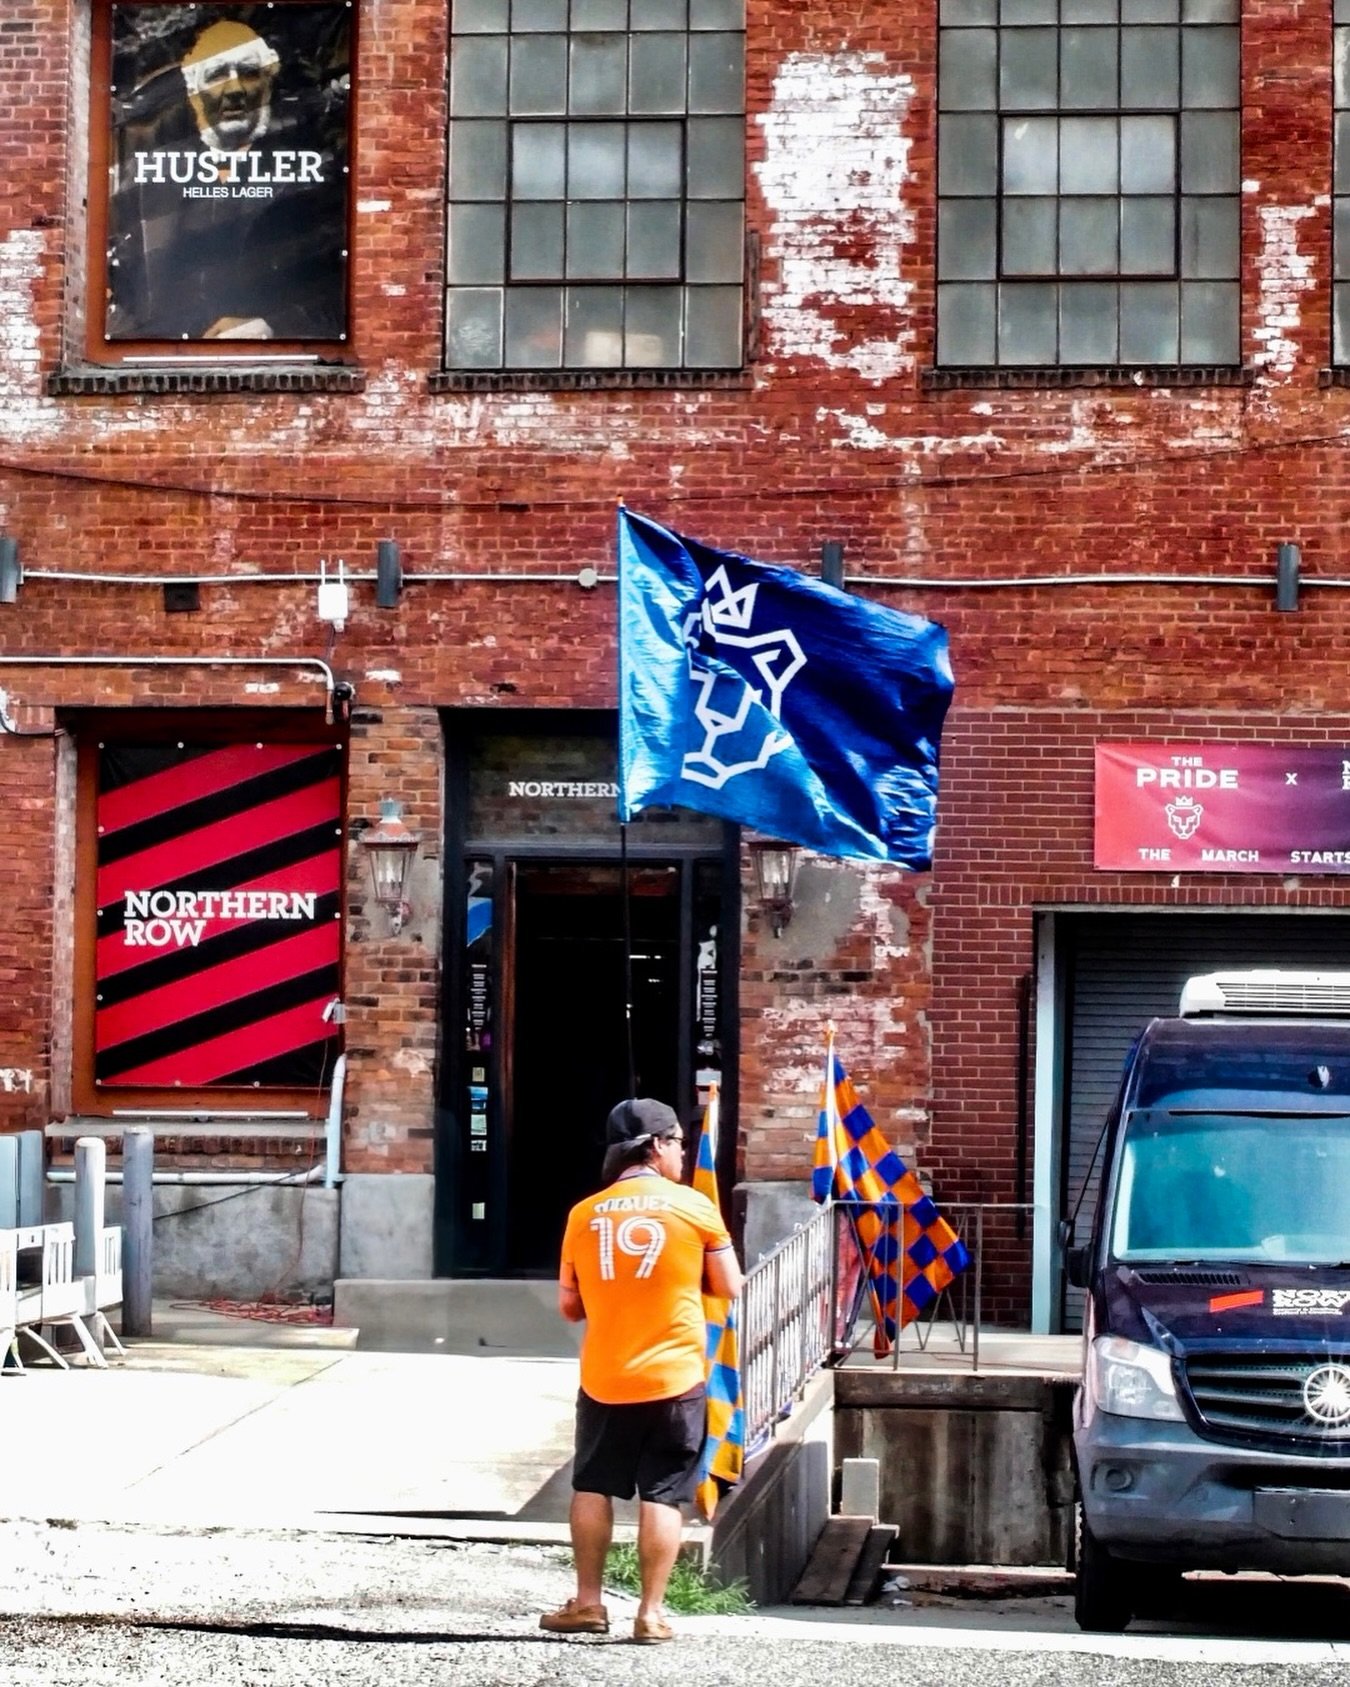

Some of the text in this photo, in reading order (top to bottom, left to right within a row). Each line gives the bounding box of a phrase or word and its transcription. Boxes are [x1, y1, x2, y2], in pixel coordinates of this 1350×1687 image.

[134, 150, 324, 183] HUSTLER
[183, 187, 273, 198] HELLES LAGER
[1171, 756, 1203, 767] THE
[1136, 767, 1239, 789] PRIDE
[1138, 848, 1171, 860] THE
[1201, 849, 1259, 862] MARCH
[124, 890, 317, 919] NORTHERN
[124, 918, 207, 946] ROW
[590, 1216, 666, 1280] 19
